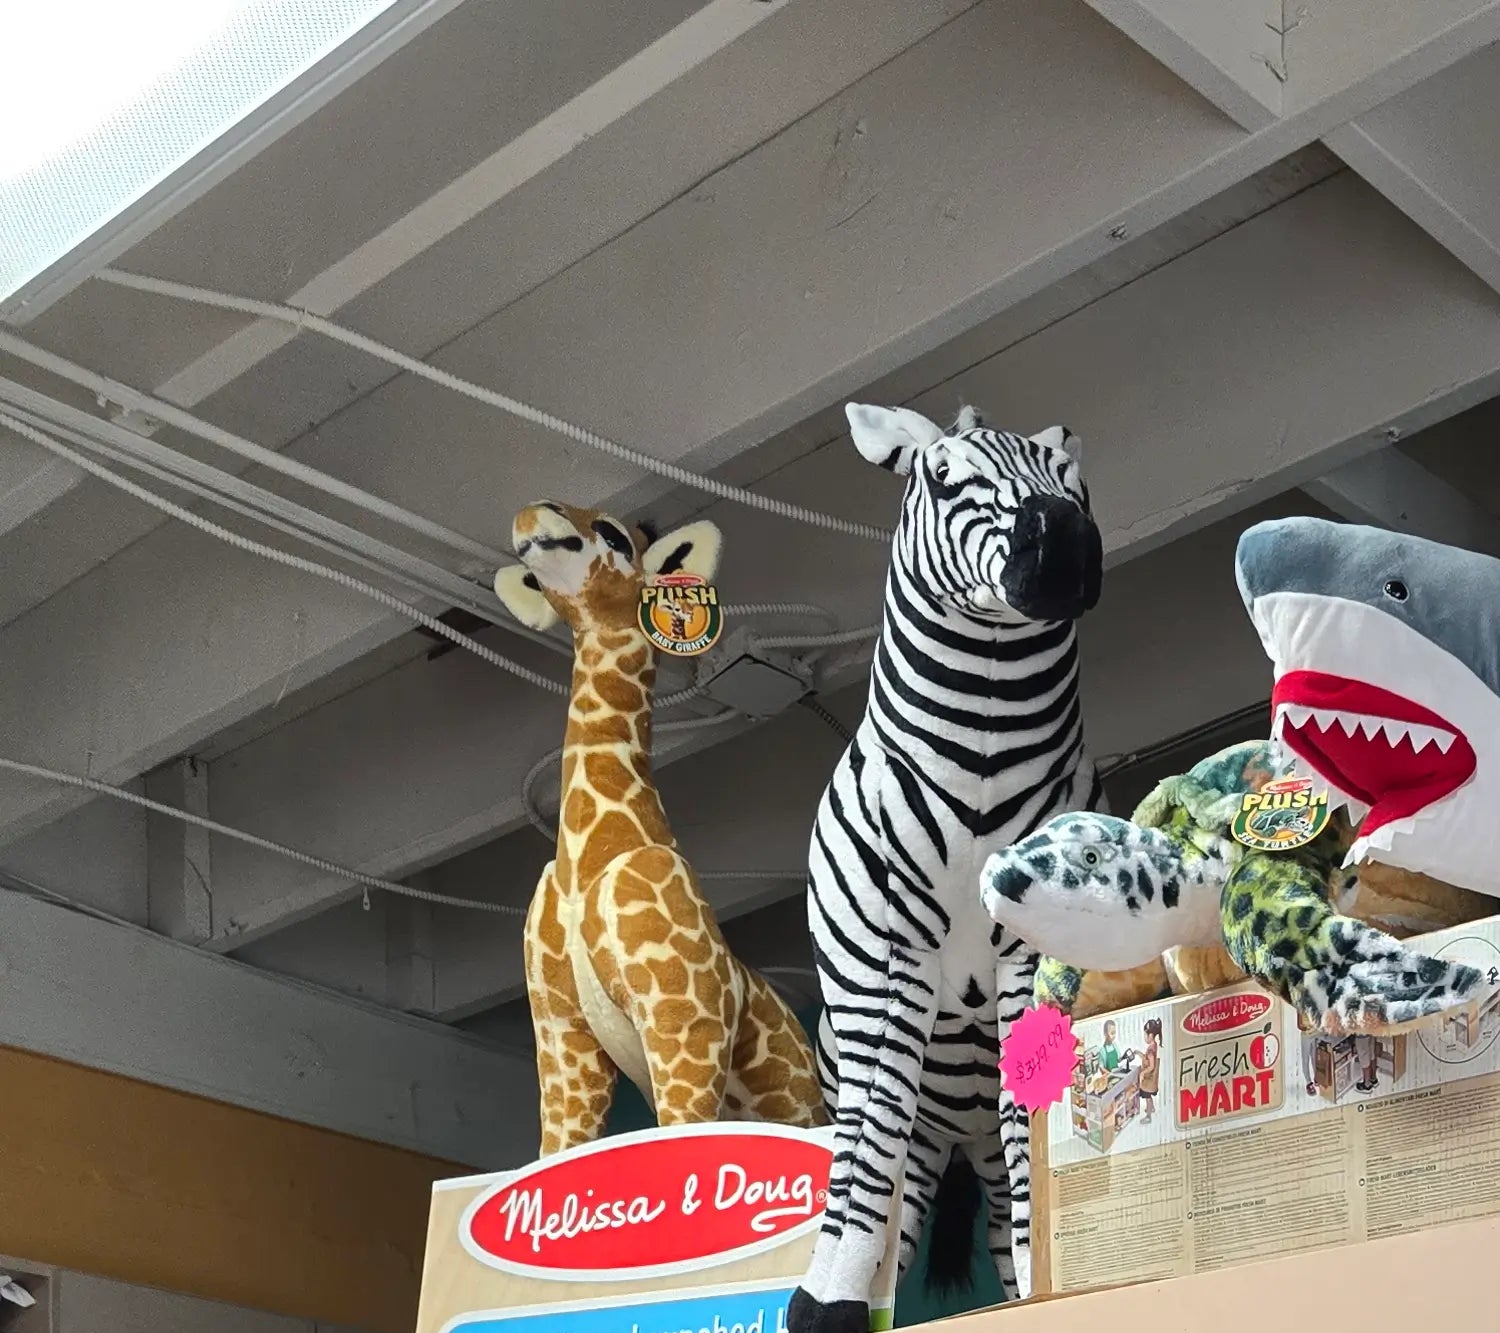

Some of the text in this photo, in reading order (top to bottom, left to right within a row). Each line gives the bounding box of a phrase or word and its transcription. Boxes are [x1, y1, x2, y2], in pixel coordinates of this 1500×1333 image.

[675, 634, 712, 652] GIRAFFE
[1242, 789, 1329, 811] PLUSH
[1180, 1045, 1250, 1087] Fresh
[1180, 1070, 1275, 1123] MART
[500, 1188, 666, 1253] Melissa
[682, 1173, 701, 1215] &
